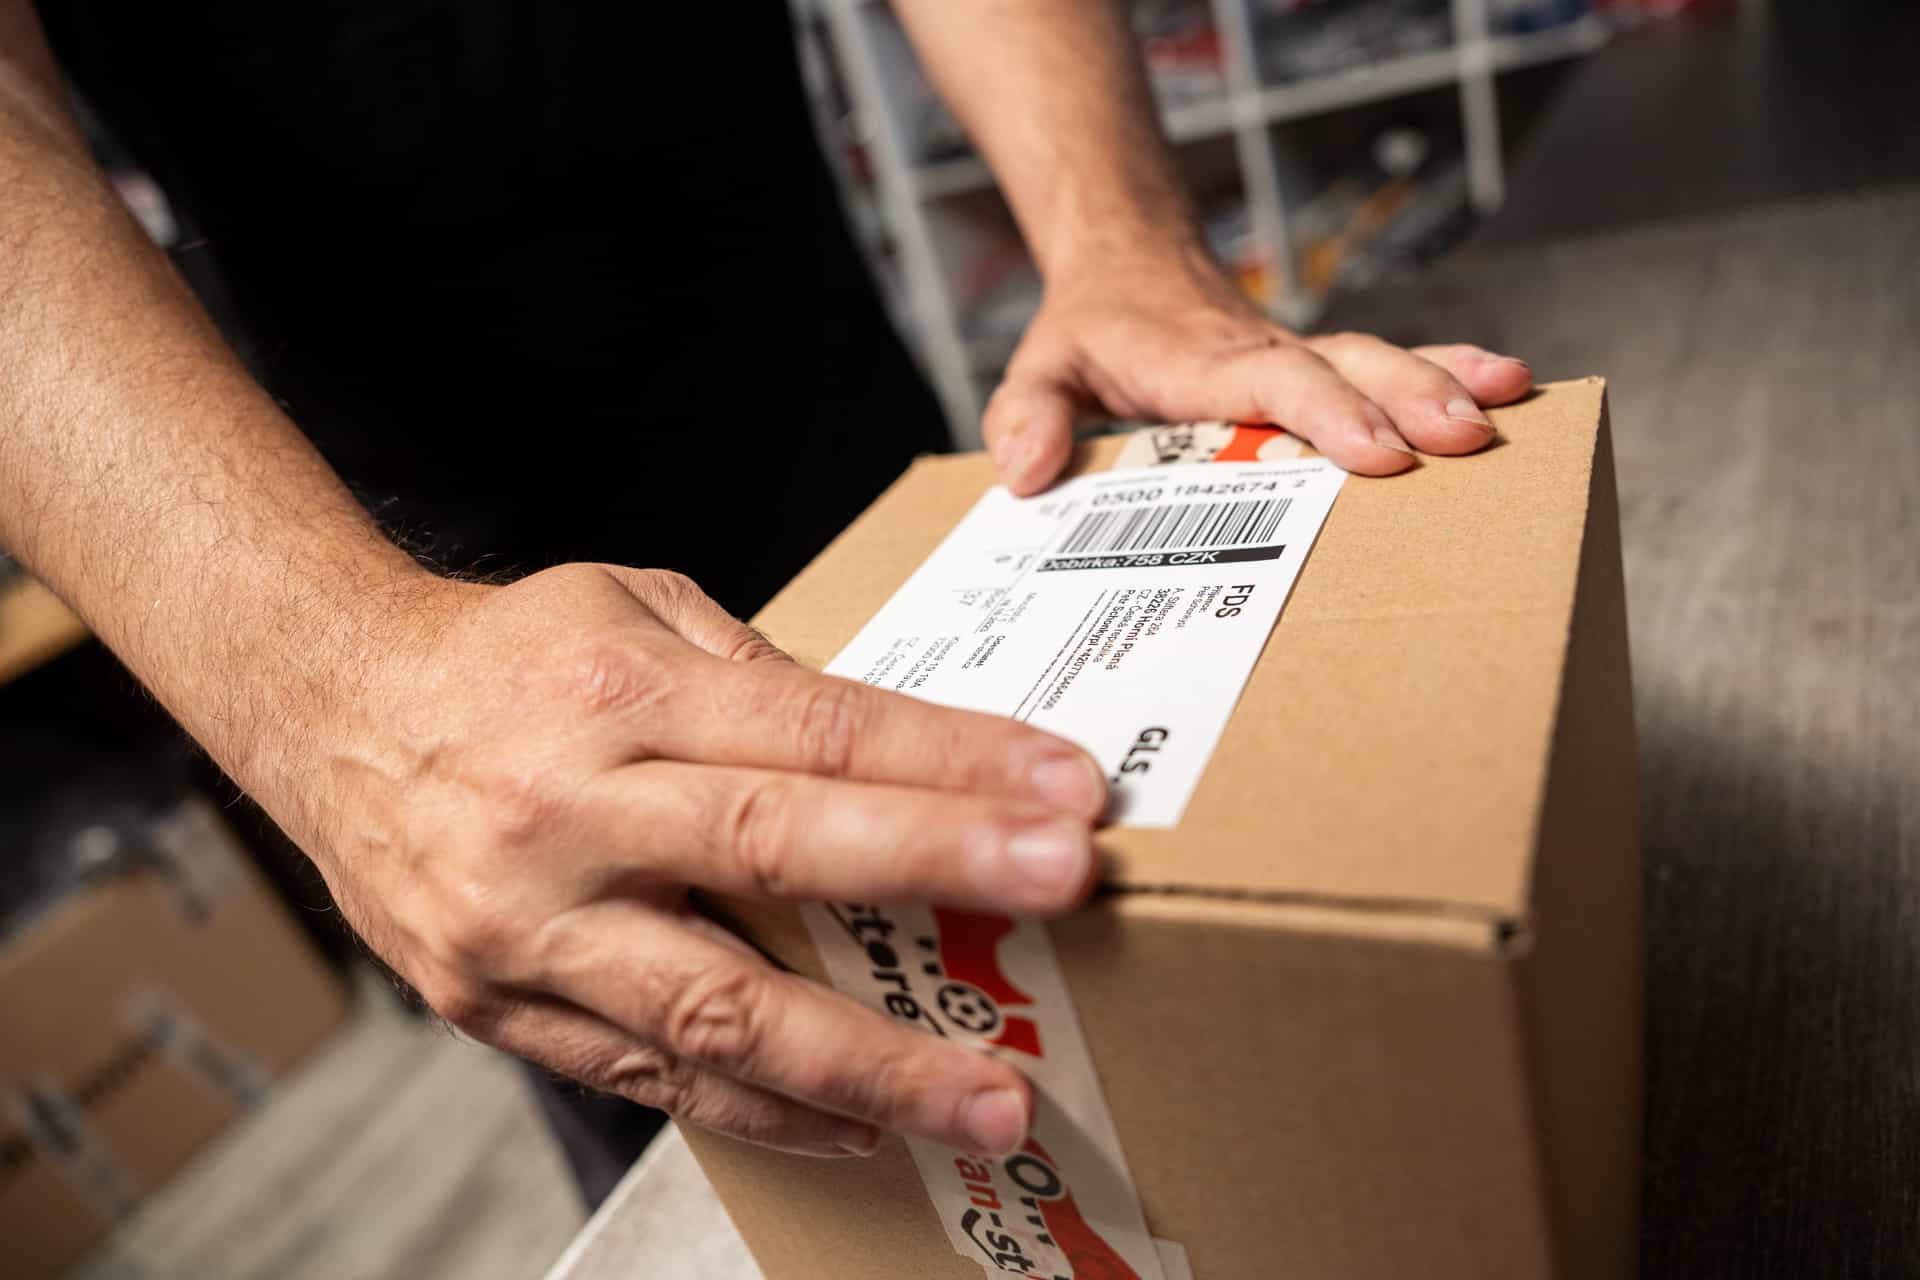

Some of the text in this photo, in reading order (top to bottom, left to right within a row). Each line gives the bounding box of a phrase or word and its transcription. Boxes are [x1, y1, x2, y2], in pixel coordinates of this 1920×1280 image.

[1093, 487, 1163, 507] 0500
[1174, 480, 1278, 497] 1842674
[1293, 479, 1307, 489] 2
[1168, 550, 1220, 565] CZK
[1118, 590, 1136, 604] Petr
[1136, 589, 1152, 599] CZ
[1215, 585, 1255, 618] FDS
[1105, 589, 1170, 670] 38226 Horní Planá
[1117, 606, 1143, 628] Česká
[1093, 629, 1122, 662] republika
[954, 1155, 1036, 1273] an-st
